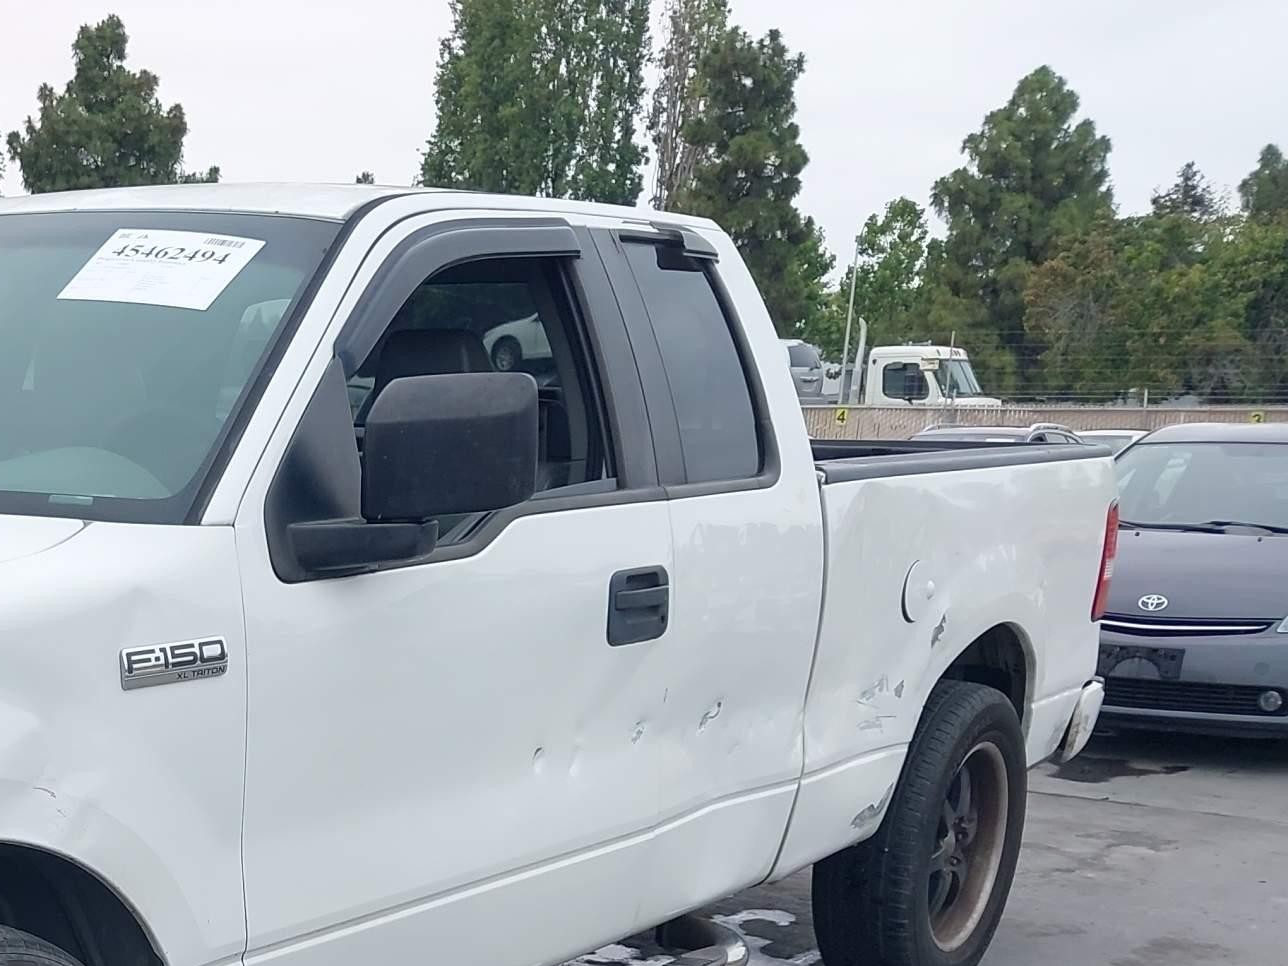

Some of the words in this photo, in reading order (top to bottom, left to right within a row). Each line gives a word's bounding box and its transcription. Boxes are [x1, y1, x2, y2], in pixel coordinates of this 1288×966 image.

[112, 244, 233, 264] 45462494
[836, 410, 846, 423] 4
[176, 672, 189, 680] XL
[191, 665, 226, 678] TRITON
